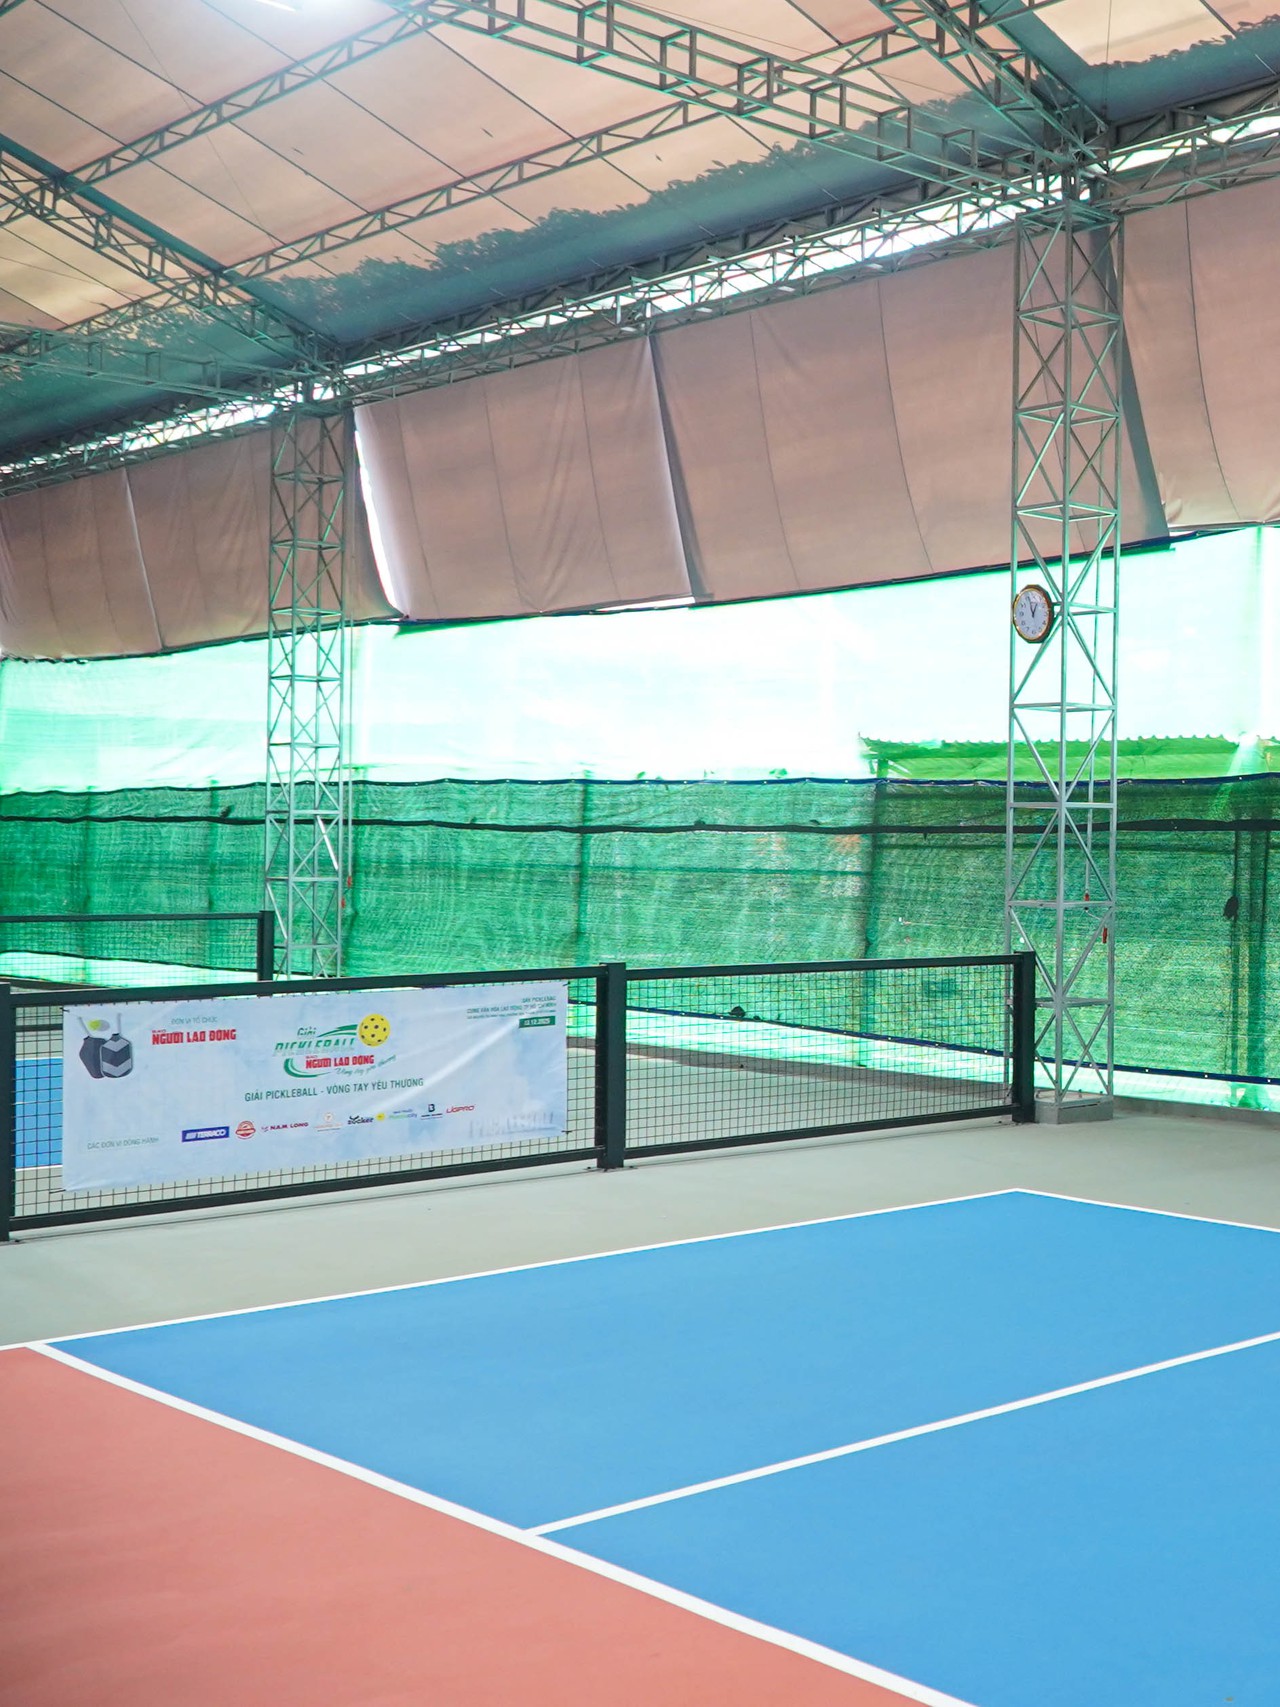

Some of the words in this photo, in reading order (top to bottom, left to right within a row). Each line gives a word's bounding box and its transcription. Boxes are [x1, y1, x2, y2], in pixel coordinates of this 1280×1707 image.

[187, 1030, 206, 1043] LAO
[334, 1057, 350, 1067] LAO
[265, 1088, 318, 1101] PICKLEBALL
[353, 1081, 368, 1092] TAY
[371, 1079, 388, 1091] YÊU
